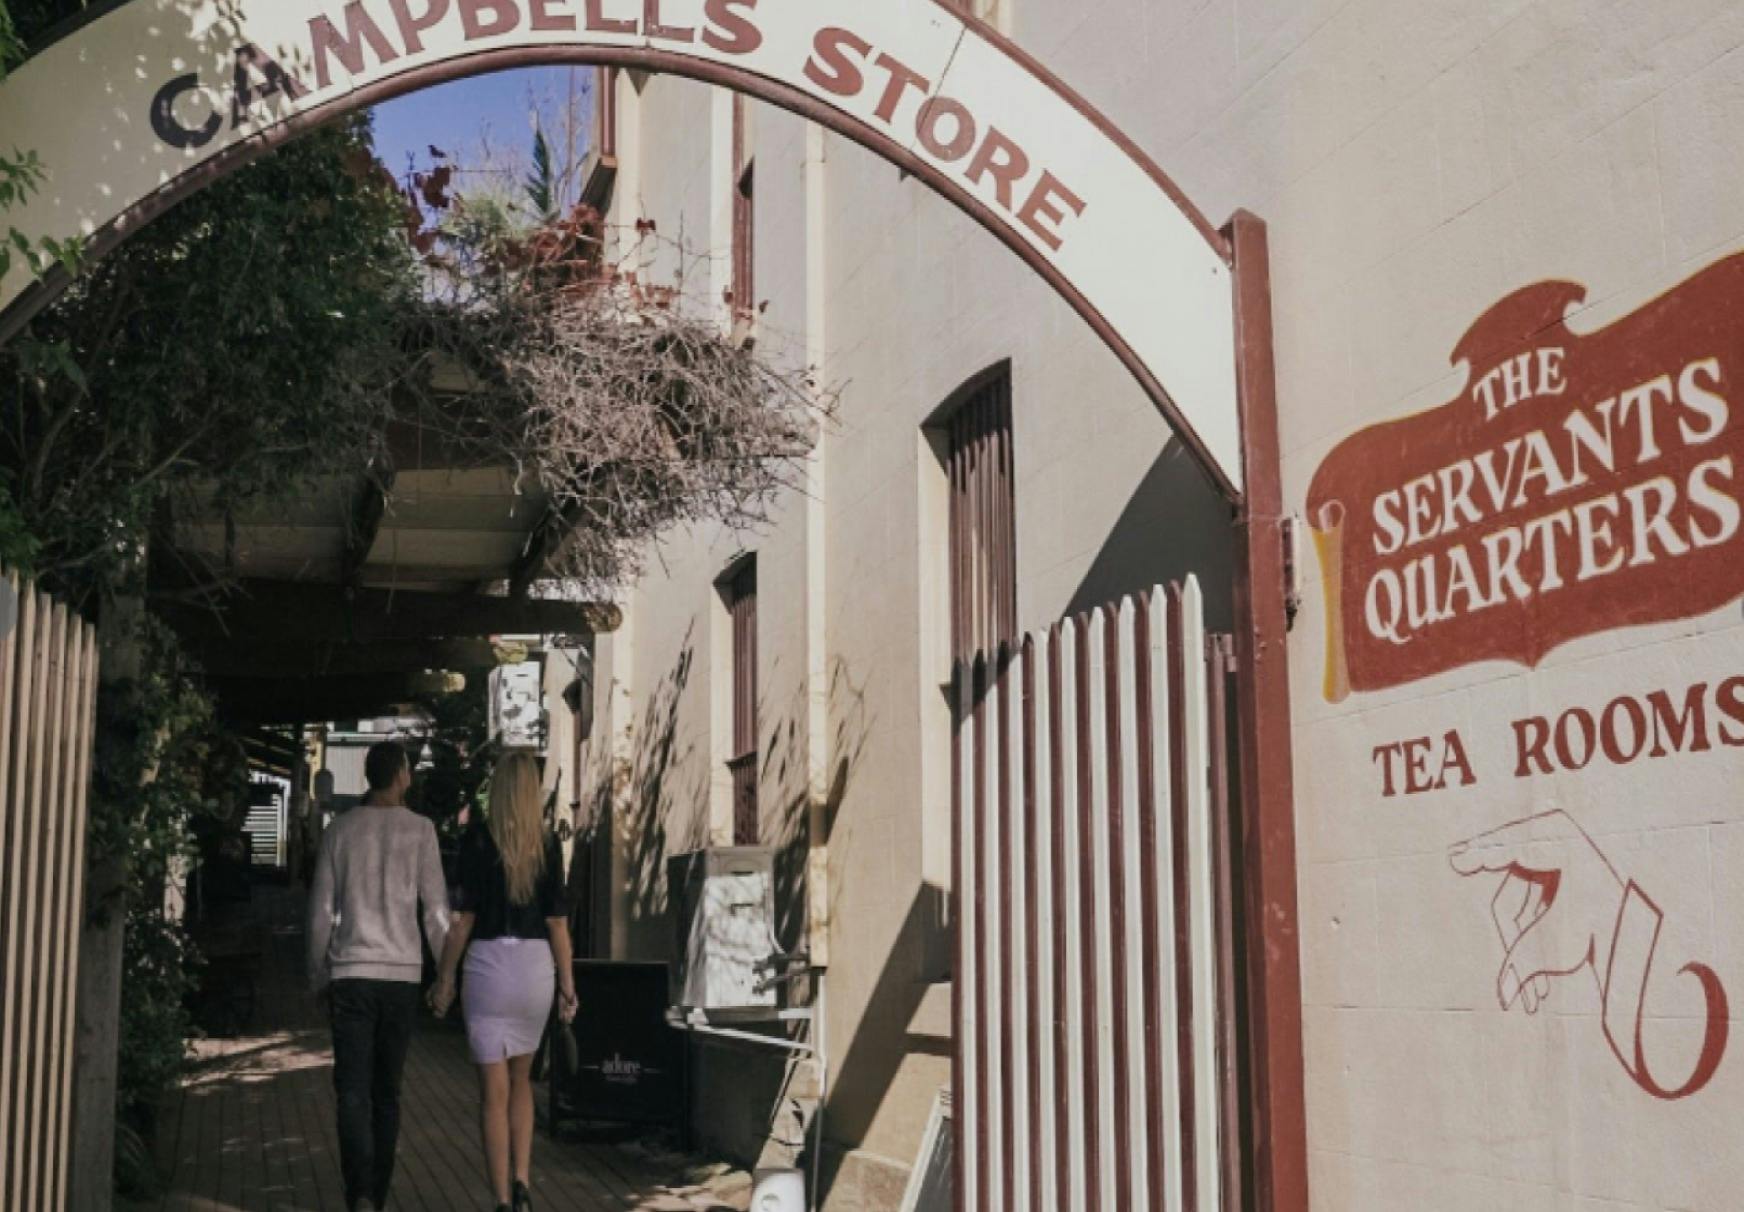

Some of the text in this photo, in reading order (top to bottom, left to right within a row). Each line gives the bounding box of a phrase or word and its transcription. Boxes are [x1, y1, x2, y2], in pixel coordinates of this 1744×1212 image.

[802, 26, 1087, 252] STORE
[1373, 357, 1729, 554] SERVANTS
[1473, 347, 1567, 421] THE
[1365, 455, 1741, 644] QUARTERS
[1373, 675, 1744, 797] TEA ROOMS
